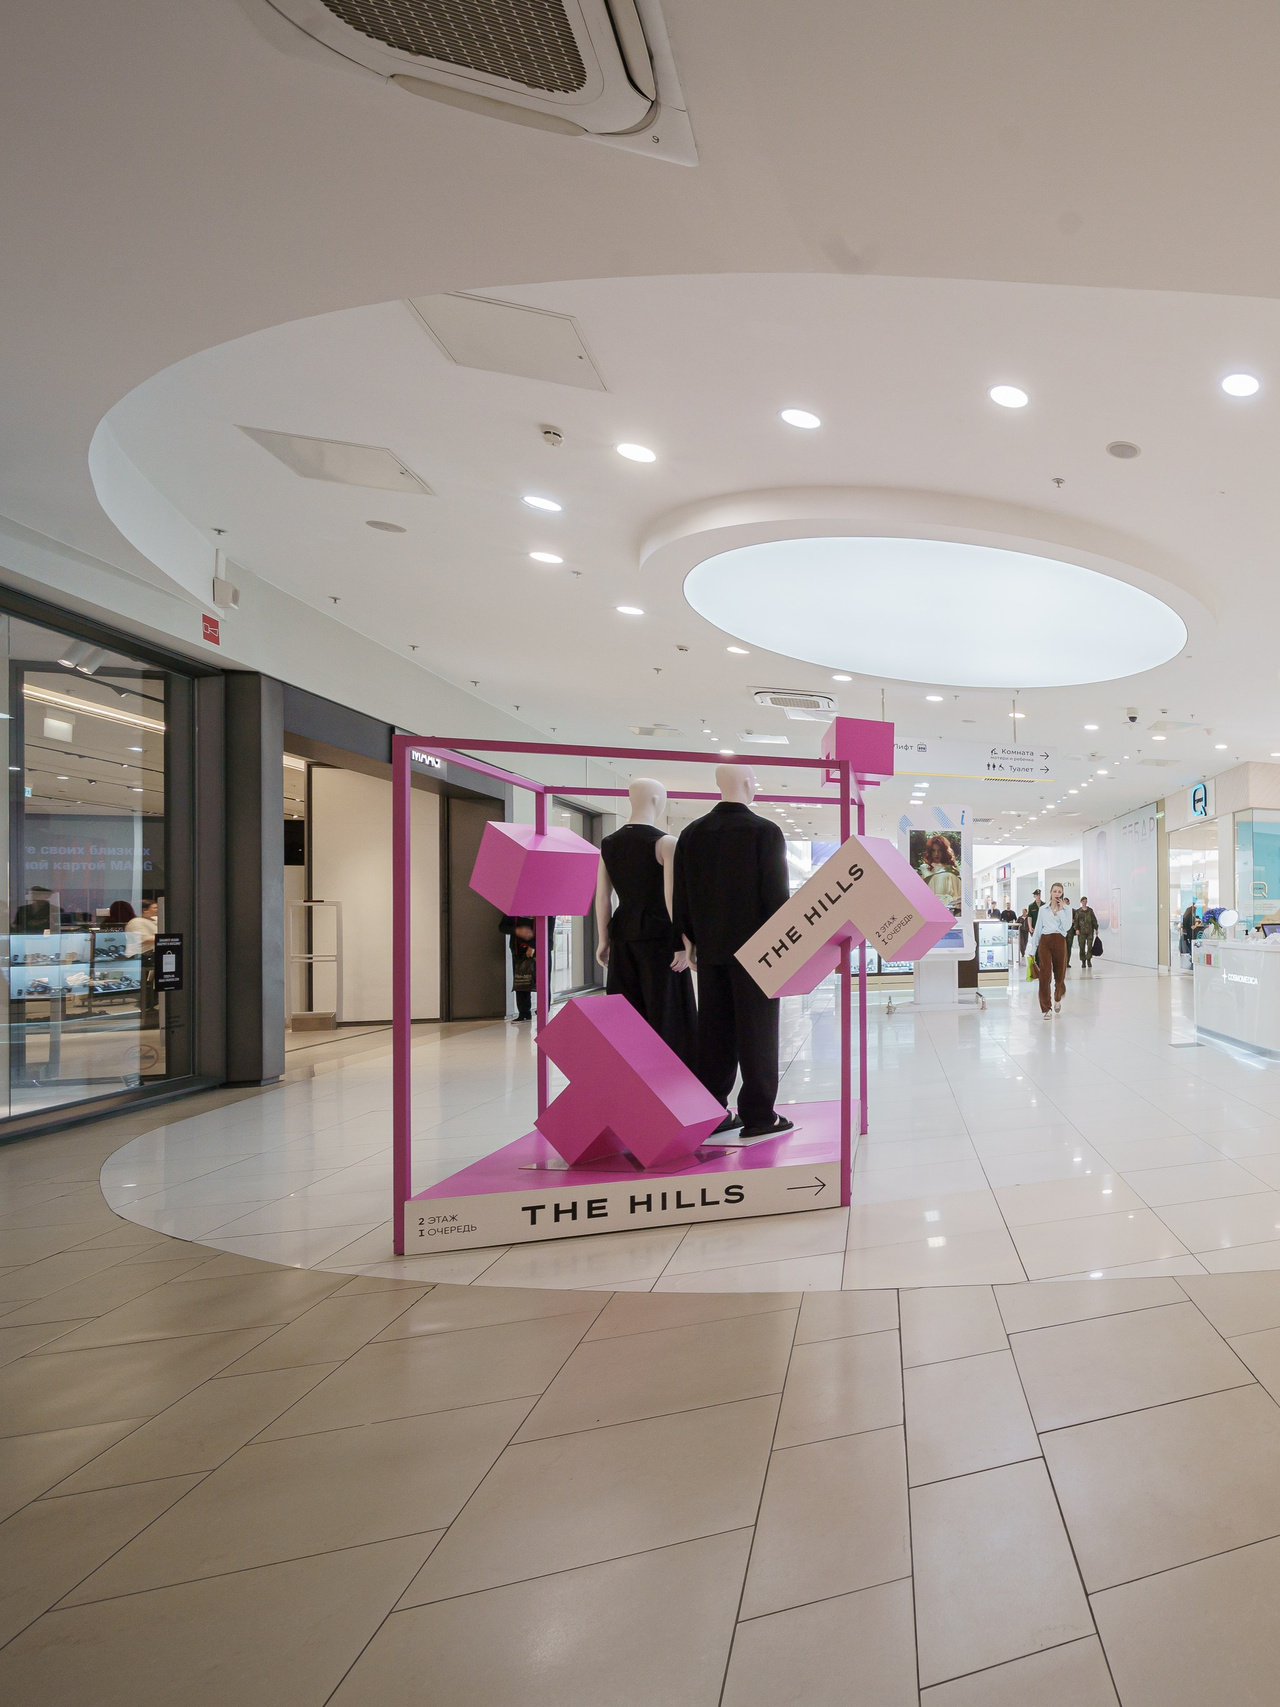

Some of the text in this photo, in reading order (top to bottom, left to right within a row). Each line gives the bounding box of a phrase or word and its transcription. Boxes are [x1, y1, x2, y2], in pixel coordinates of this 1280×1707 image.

[1009, 765, 1034, 773] Туалет
[40, 846, 85, 855] своих
[89, 844, 151, 856] близкх
[53, 861, 106, 872] картой
[110, 861, 153, 871] MAG
[757, 863, 864, 968] THE HILLS
[875, 914, 898, 939] 2 ЭТАЖ
[886, 914, 914, 941] ОЧЕРЕДЬ
[521, 1184, 746, 1226] THE HILLS
[418, 1213, 459, 1226] 2 ЭТАЖ
[427, 1224, 478, 1237] ОЧЕРЕДЬ
